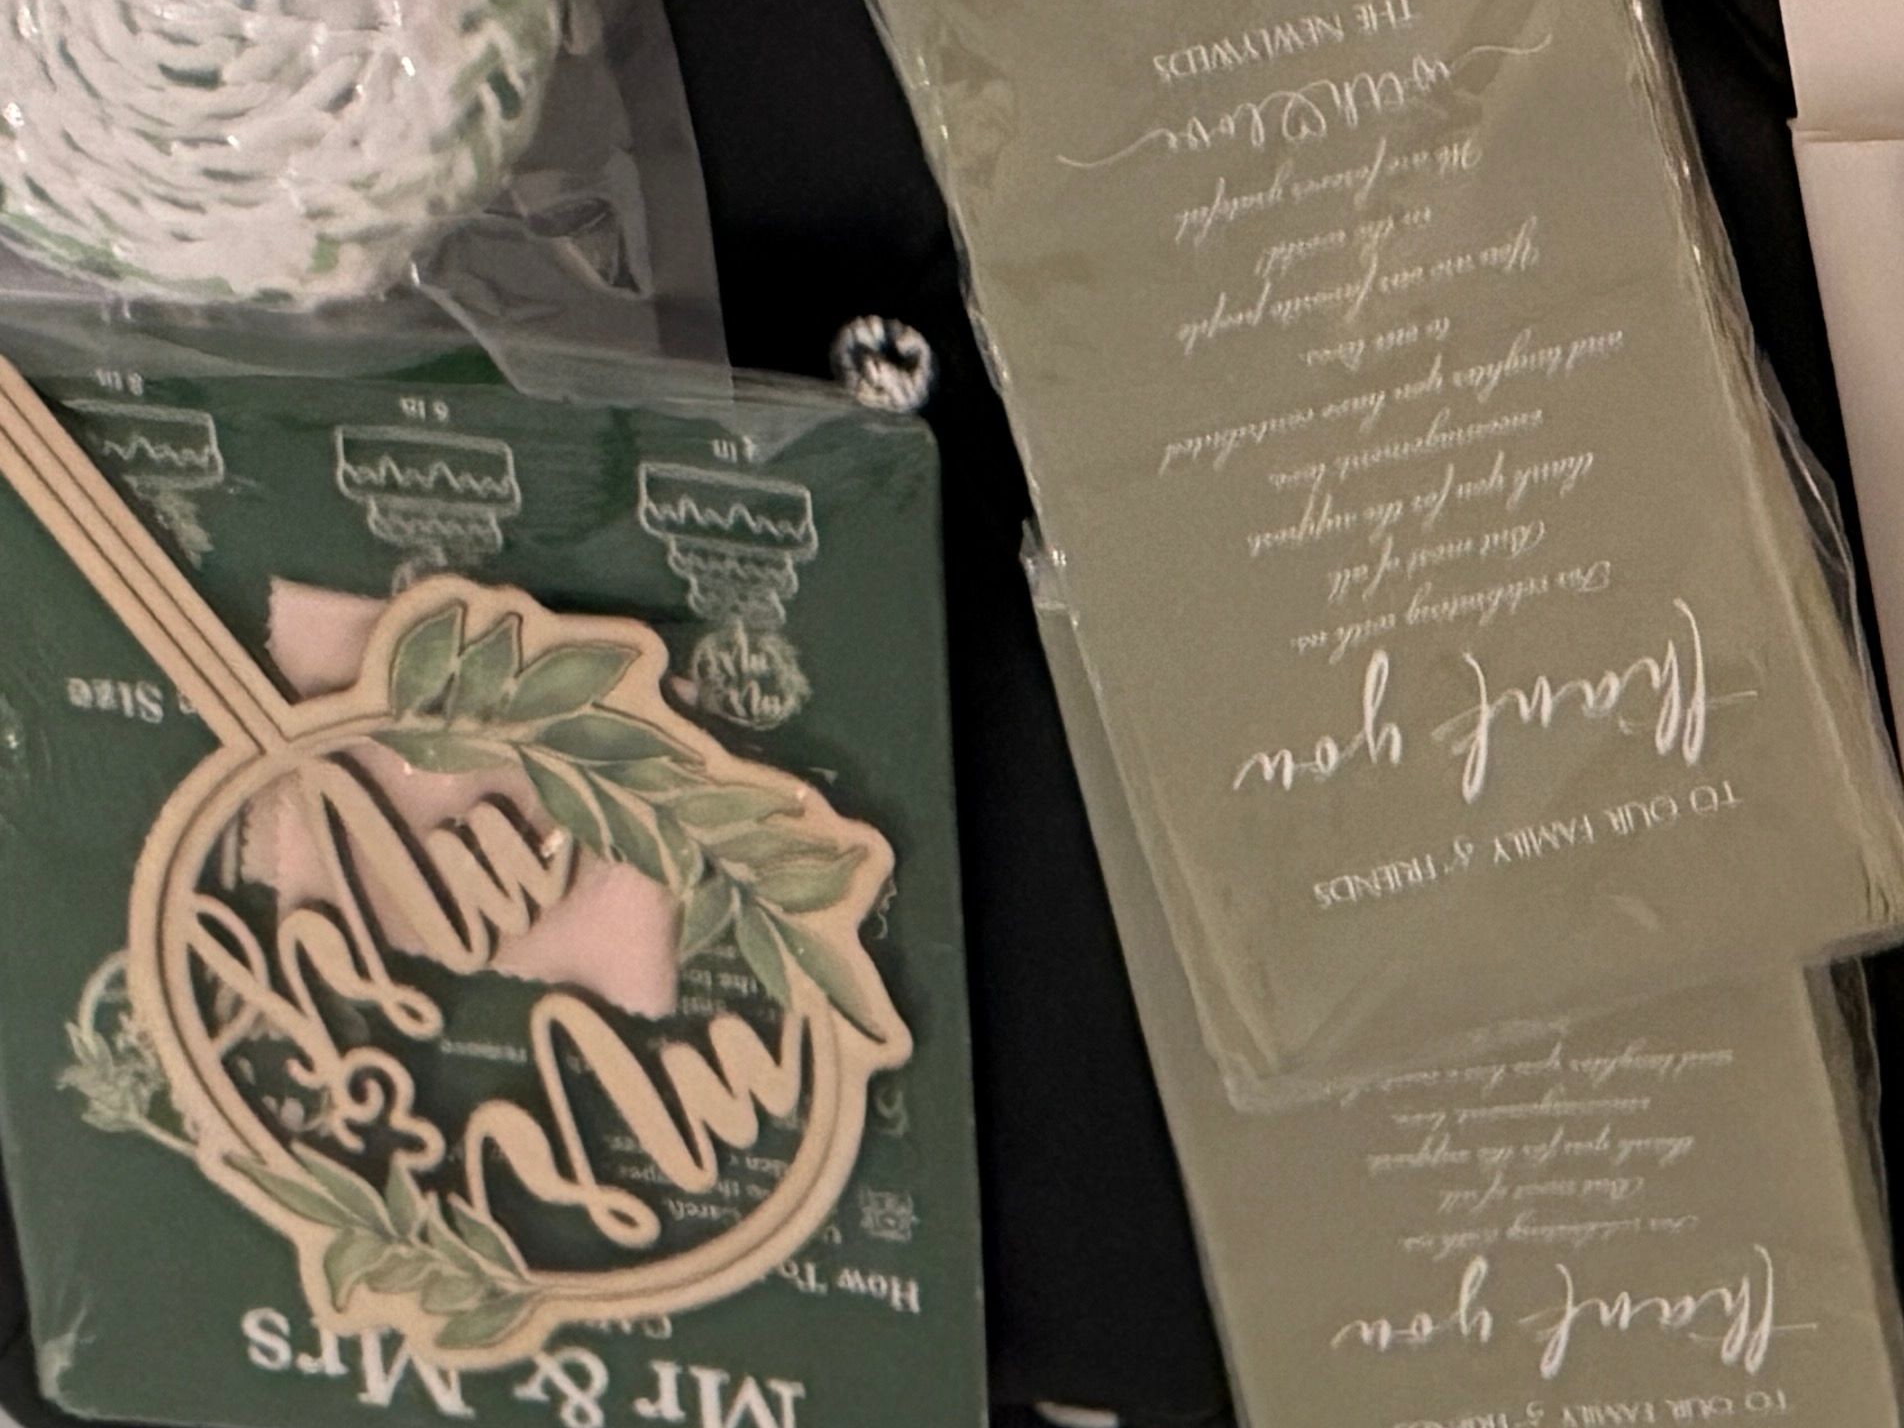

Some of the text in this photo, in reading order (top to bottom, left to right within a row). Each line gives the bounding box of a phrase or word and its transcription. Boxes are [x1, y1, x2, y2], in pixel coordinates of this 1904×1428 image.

[1151, 14, 1345, 84] NEWLYWEDS
[1478, 214, 1540, 272] You
[1175, 277, 1272, 355] people
[1451, 328, 1564, 403] laughter
[1565, 329, 1624, 370] and
[1392, 352, 1445, 404] you
[1321, 386, 1387, 434] have
[1362, 450, 1594, 545] thank you for the
[1407, 536, 1474, 580] most
[1478, 518, 1546, 559] But
[1360, 534, 1402, 605] of
[1556, 559, 1611, 594] For
[1328, 612, 1397, 665] with
[66, 677, 163, 723] Size
[1232, 598, 1757, 804] thank you
[1603, 793, 1678, 836] OUR
[1689, 779, 1742, 817] TO
[1492, 812, 1594, 865] FAMILY
[1311, 850, 1437, 911] FRIENDS
[327, 1046, 446, 1173] &
[836, 1268, 920, 1314] How
[1329, 1243, 1818, 1380] thank you
[240, 1308, 475, 1420] Mrs
[1665, 1395, 1733, 1425] OUR
[1745, 1388, 1787, 1416] TO
